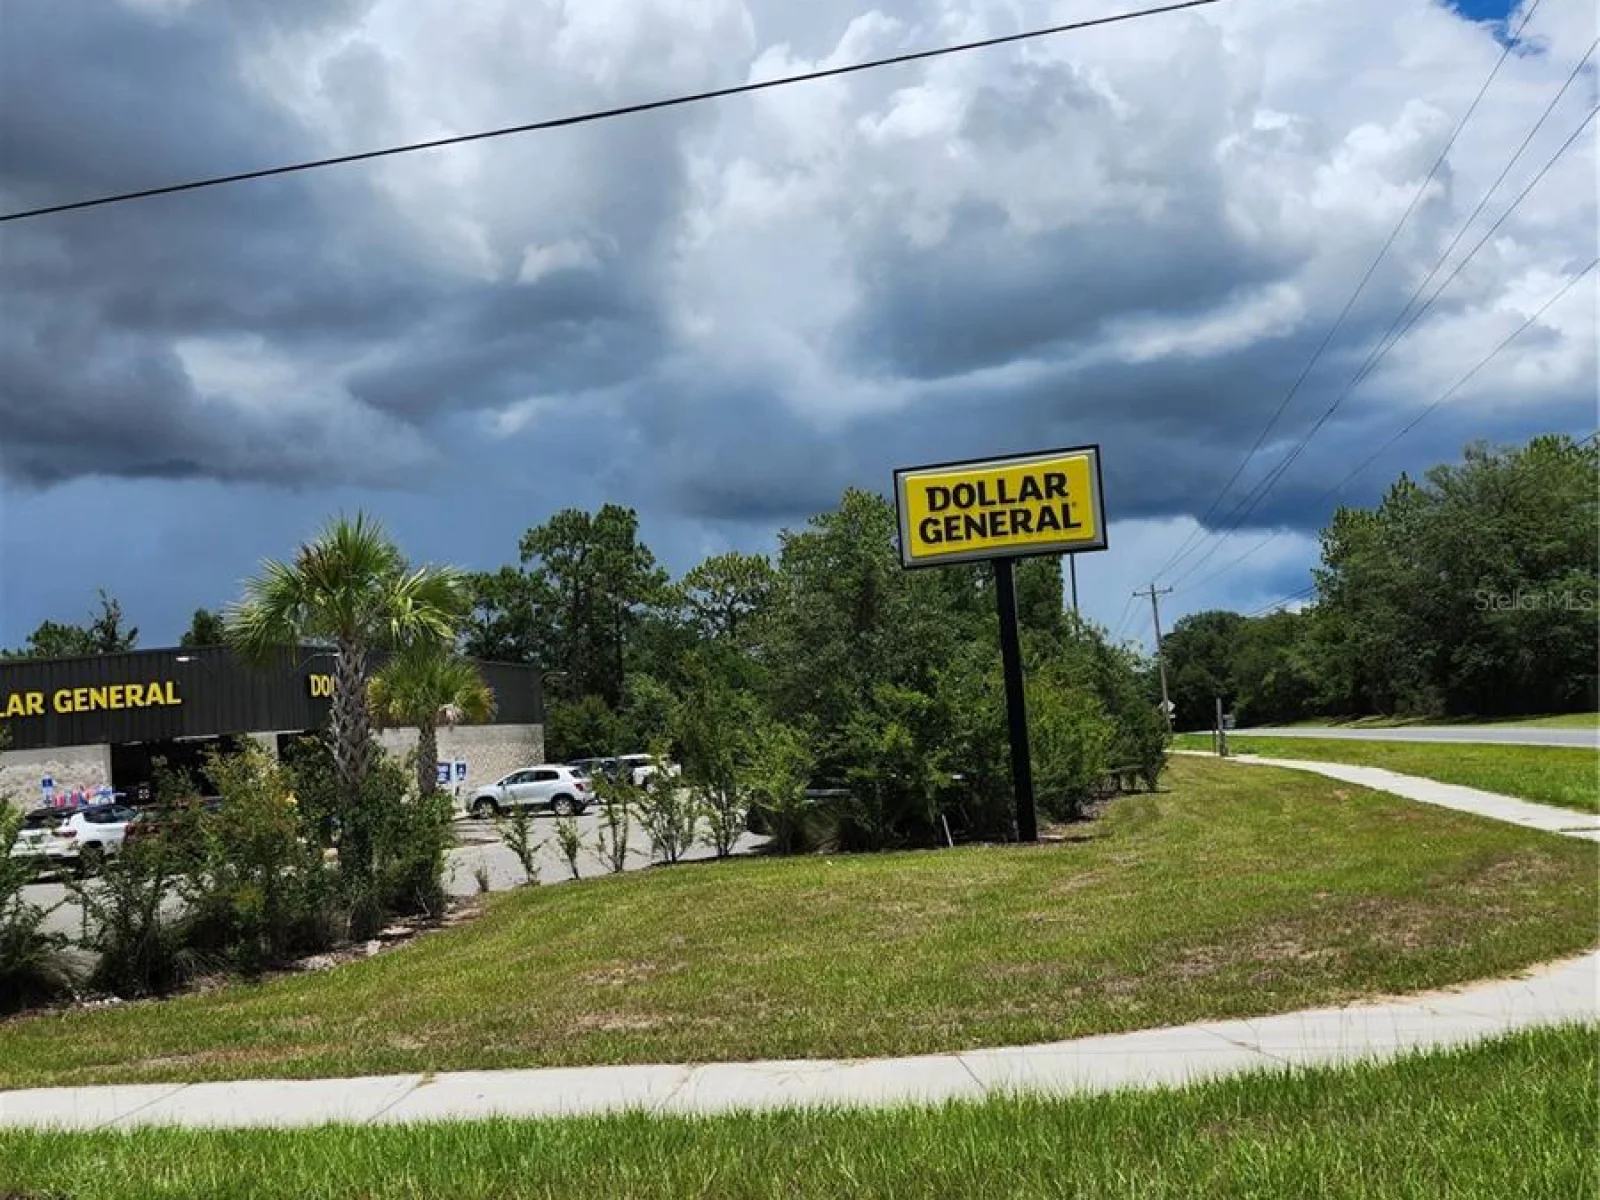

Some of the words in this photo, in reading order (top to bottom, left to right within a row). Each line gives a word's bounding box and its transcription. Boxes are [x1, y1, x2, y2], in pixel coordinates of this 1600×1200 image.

[925, 472, 1069, 512] DOLLAR
[919, 503, 1081, 544] GENERAL
[53, 681, 181, 713] GENERAL
